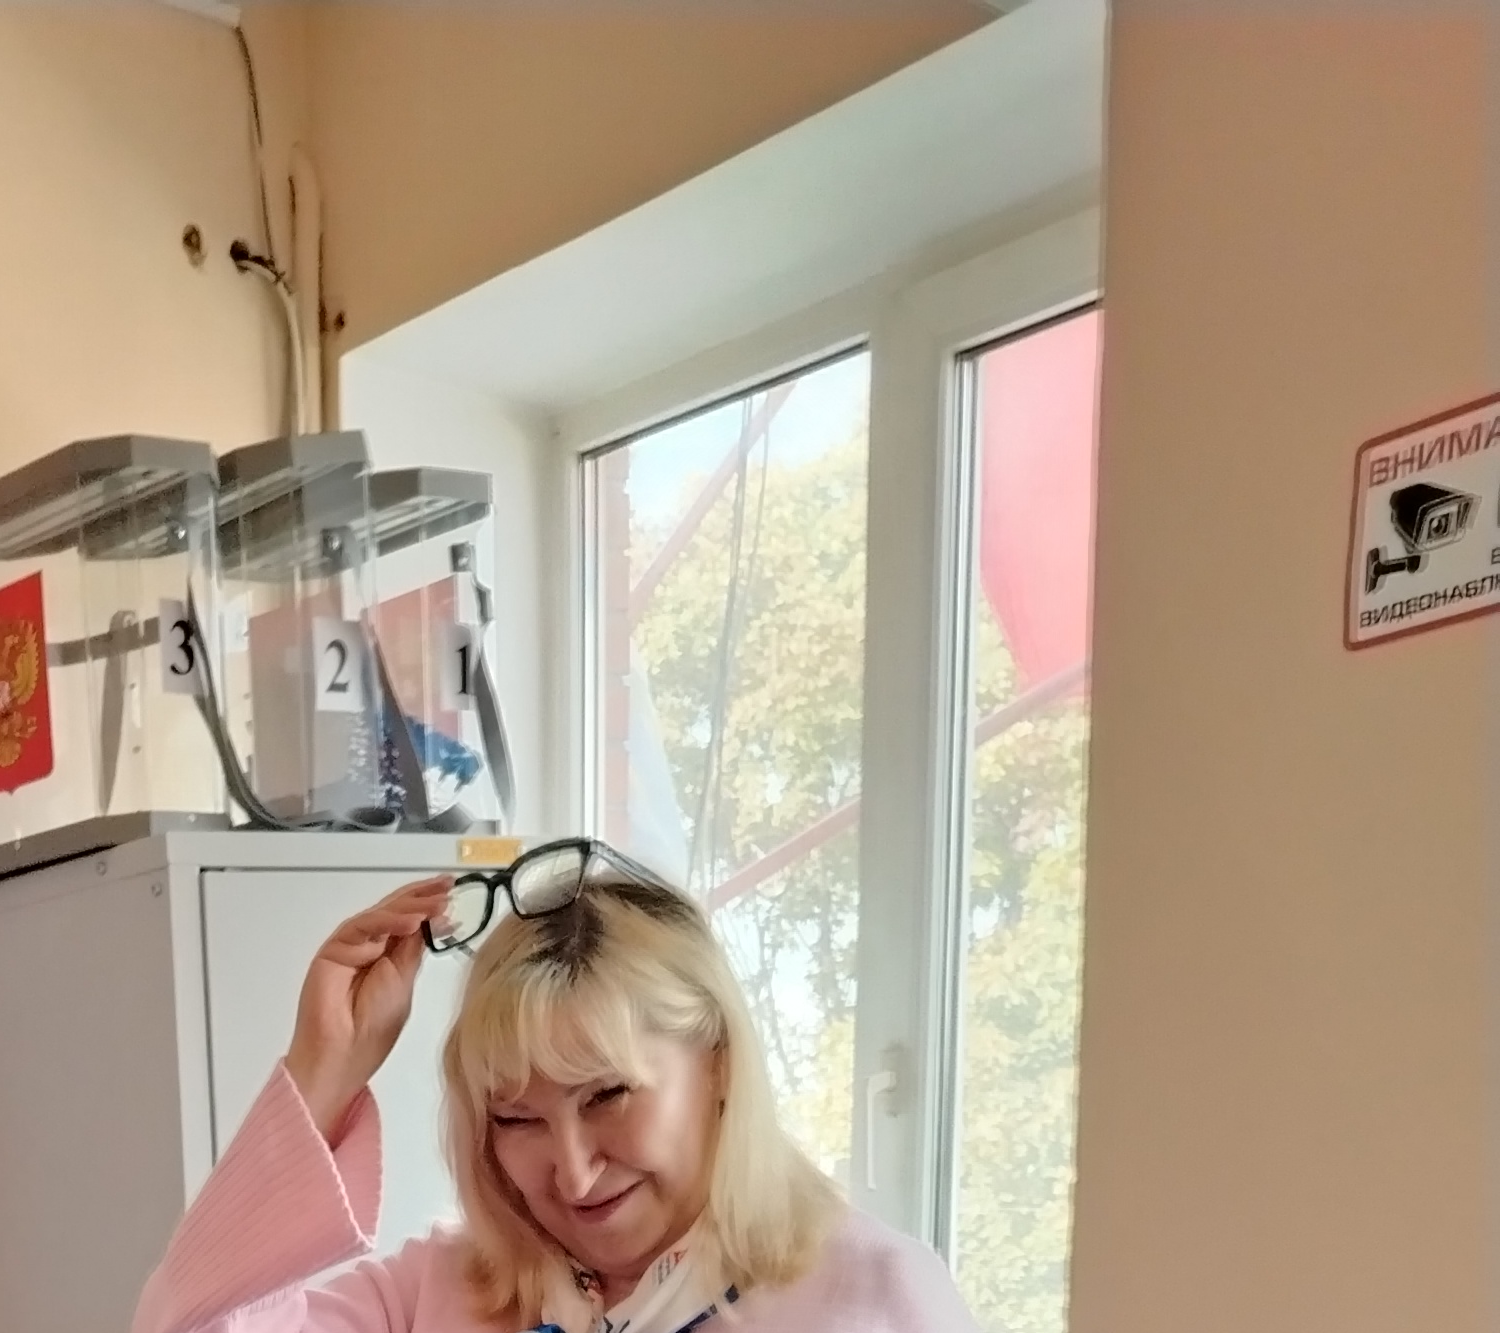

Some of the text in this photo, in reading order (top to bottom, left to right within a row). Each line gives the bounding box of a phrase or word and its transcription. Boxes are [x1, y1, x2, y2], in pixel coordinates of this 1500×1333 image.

[170, 619, 194, 675] 3
[325, 639, 349, 693] 2
[456, 645, 475, 695] 1
